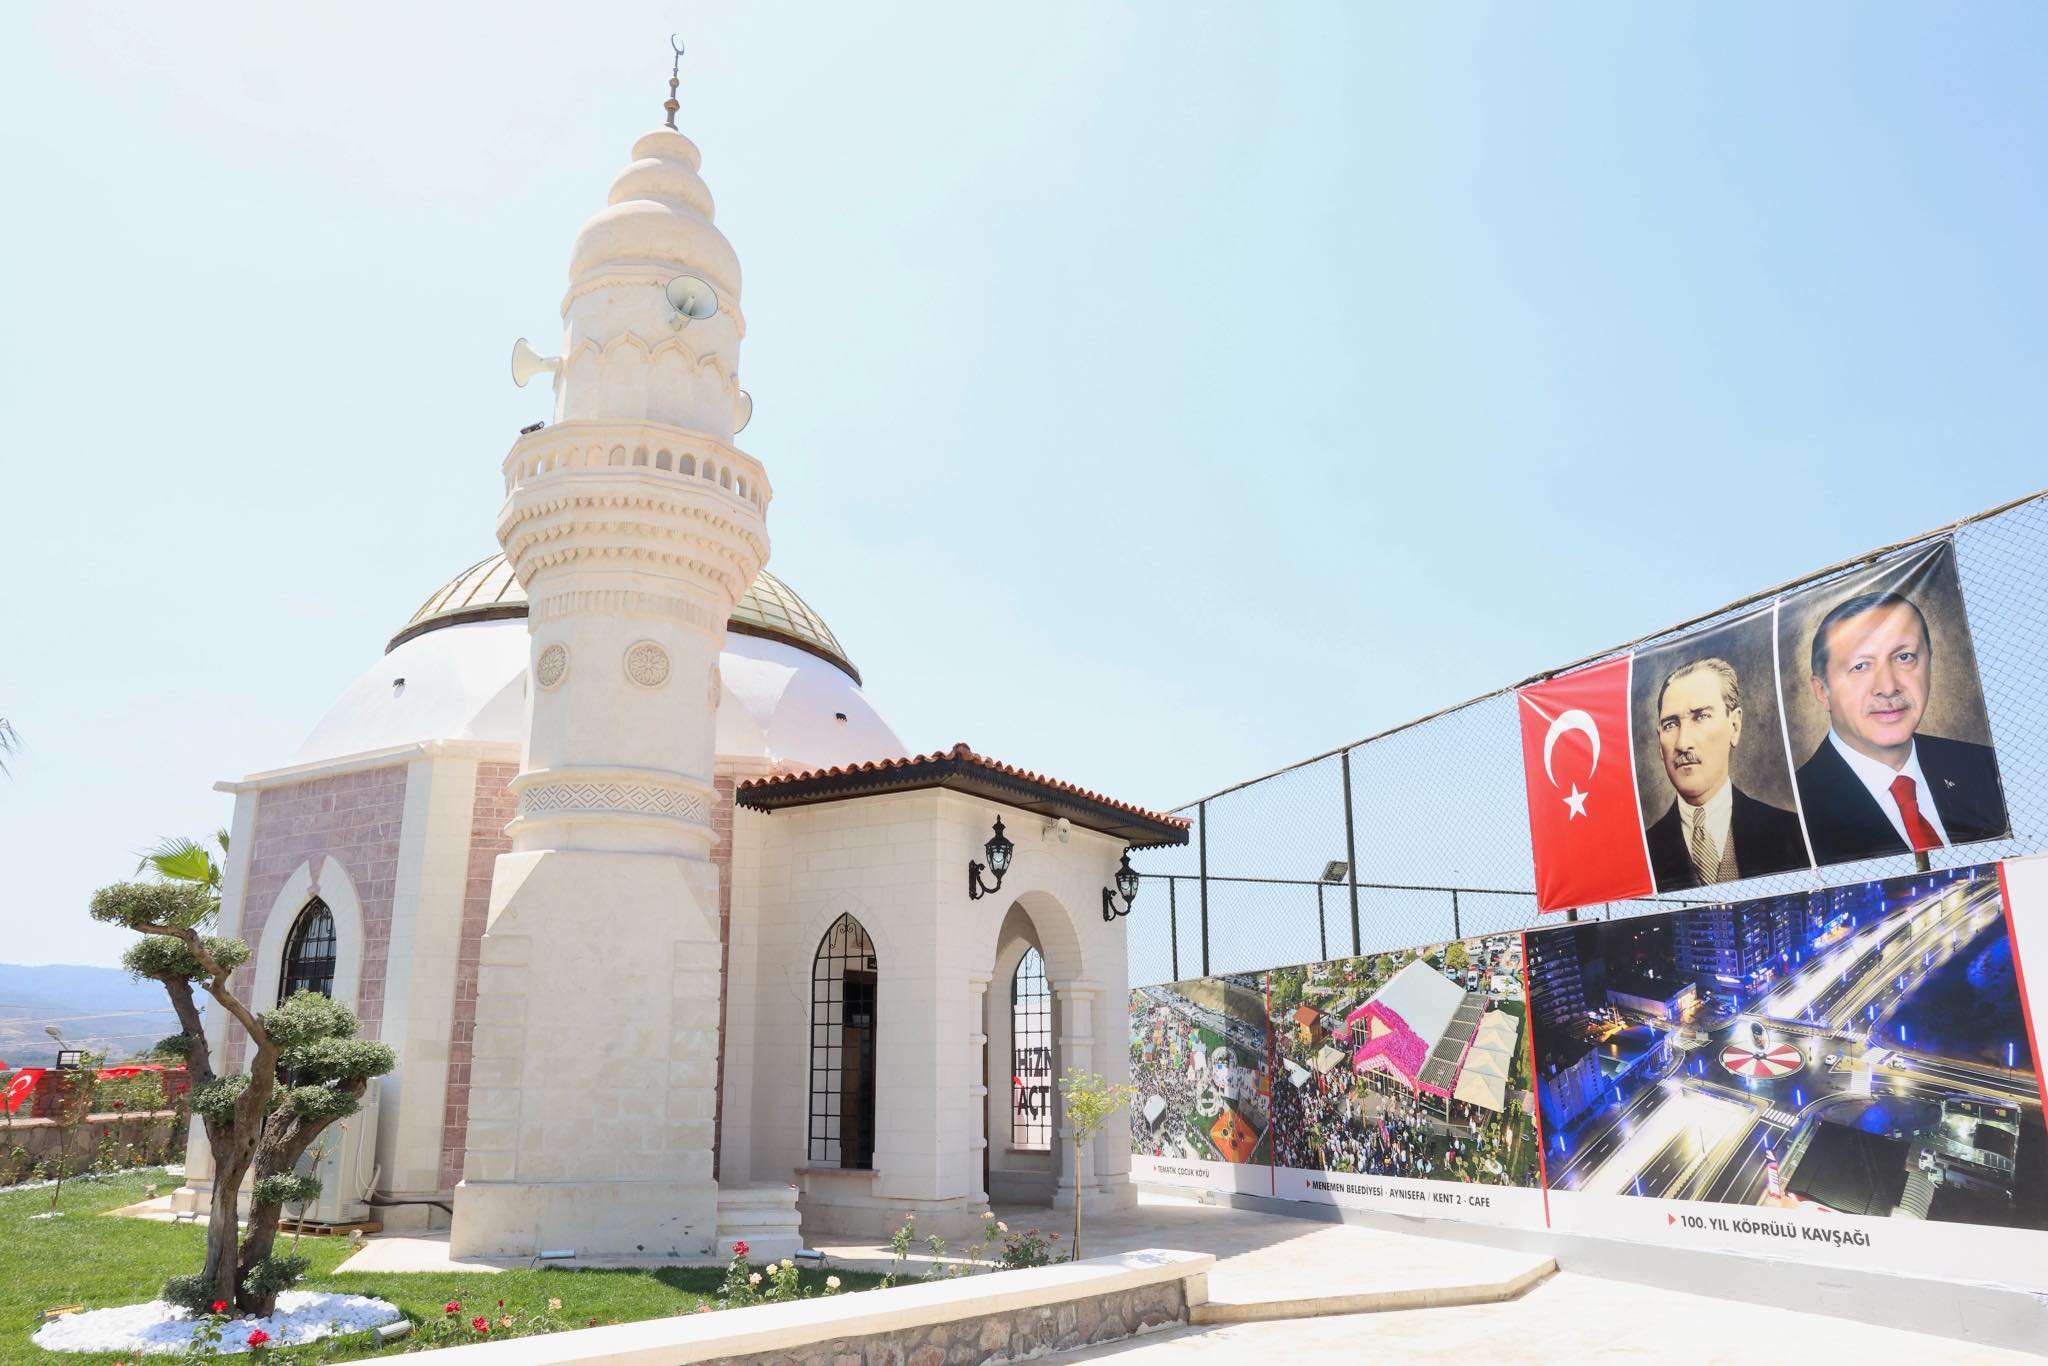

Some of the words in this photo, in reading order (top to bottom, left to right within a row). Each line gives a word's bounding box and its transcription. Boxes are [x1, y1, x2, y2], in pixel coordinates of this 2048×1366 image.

[1017, 1085, 1051, 1120] AÇT
[1312, 1180, 1345, 1193] MENEMEN
[1346, 1184, 1384, 1197] BELEDİYESİ
[1433, 1192, 1454, 1204] KENT
[1456, 1195, 1462, 1205] 2
[1469, 1196, 1490, 1207] CAFE
[1681, 1215, 1707, 1229] 100.
[1709, 1217, 1730, 1231] YIL
[1732, 1217, 1797, 1239] KÖPRÜLÜ
[1801, 1227, 1871, 1248] KAVŞAĞI
